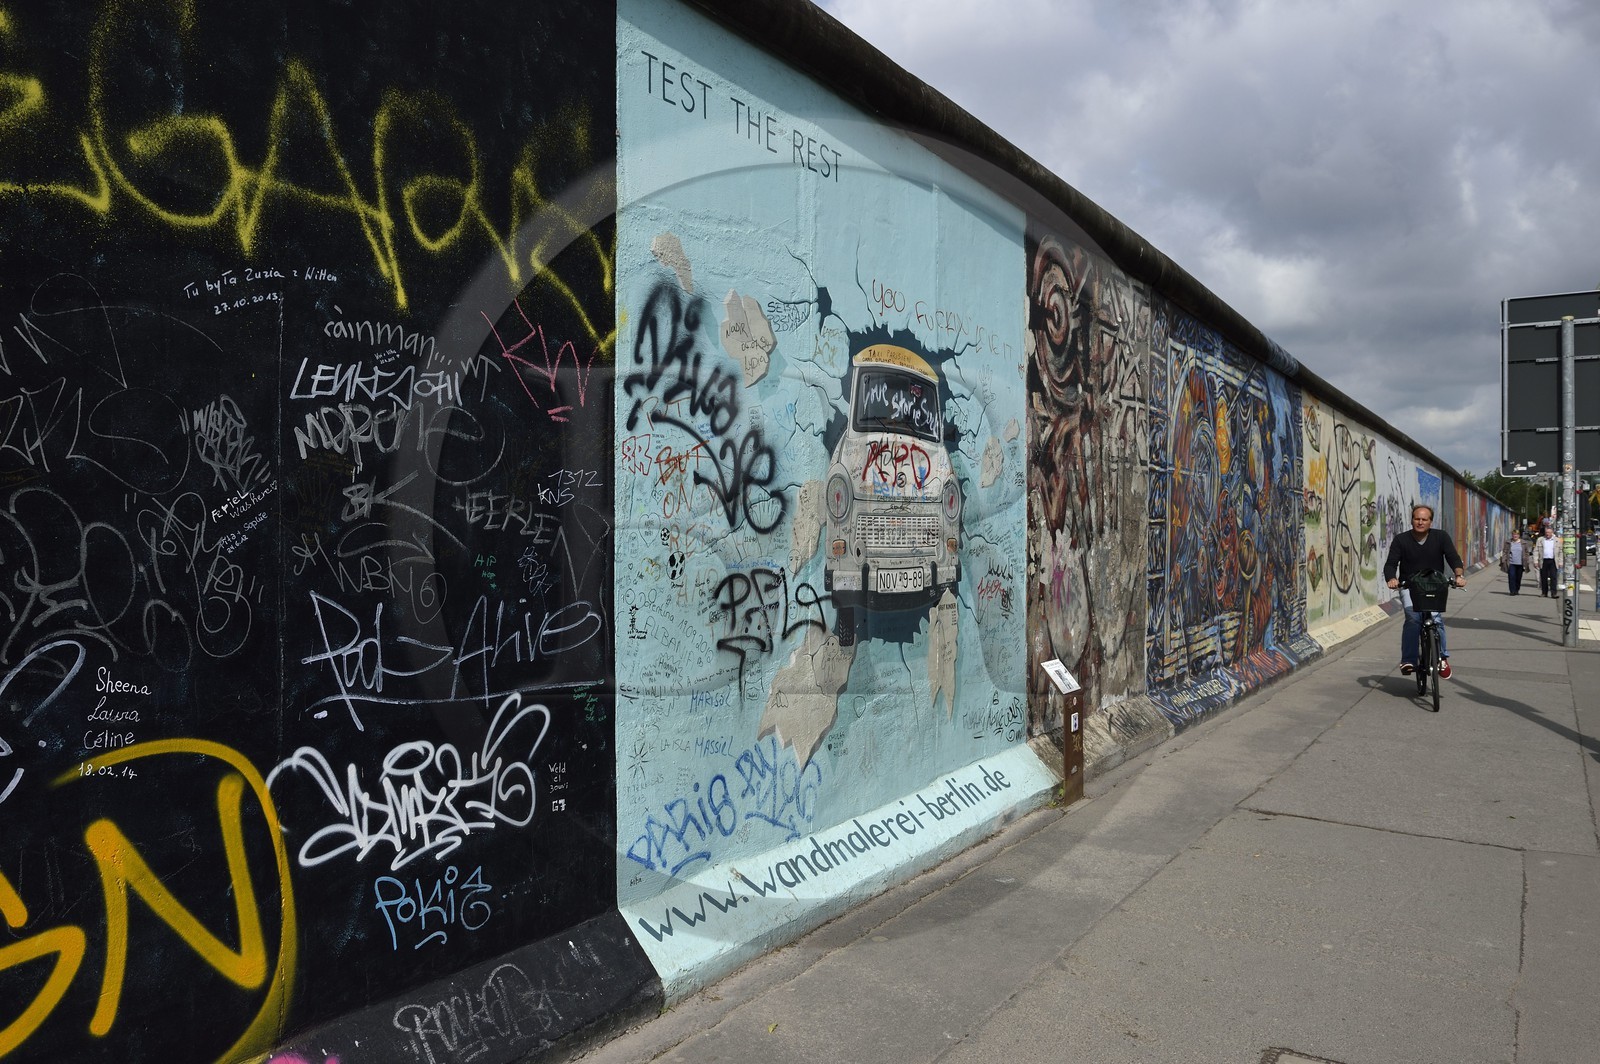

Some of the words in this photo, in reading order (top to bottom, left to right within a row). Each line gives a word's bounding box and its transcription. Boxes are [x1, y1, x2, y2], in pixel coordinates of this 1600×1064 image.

[641, 50, 713, 120] TEST
[729, 96, 778, 155] THE
[791, 128, 843, 183] REST
[879, 571, 898, 590] NOV
[95, 666, 152, 695] Sheena
[87, 696, 140, 722] Laura
[83, 730, 136, 750] Céline
[78, 762, 138, 778] 18.02.14
[638, 764, 1011, 943] www.wandmalerei-berlin.de
